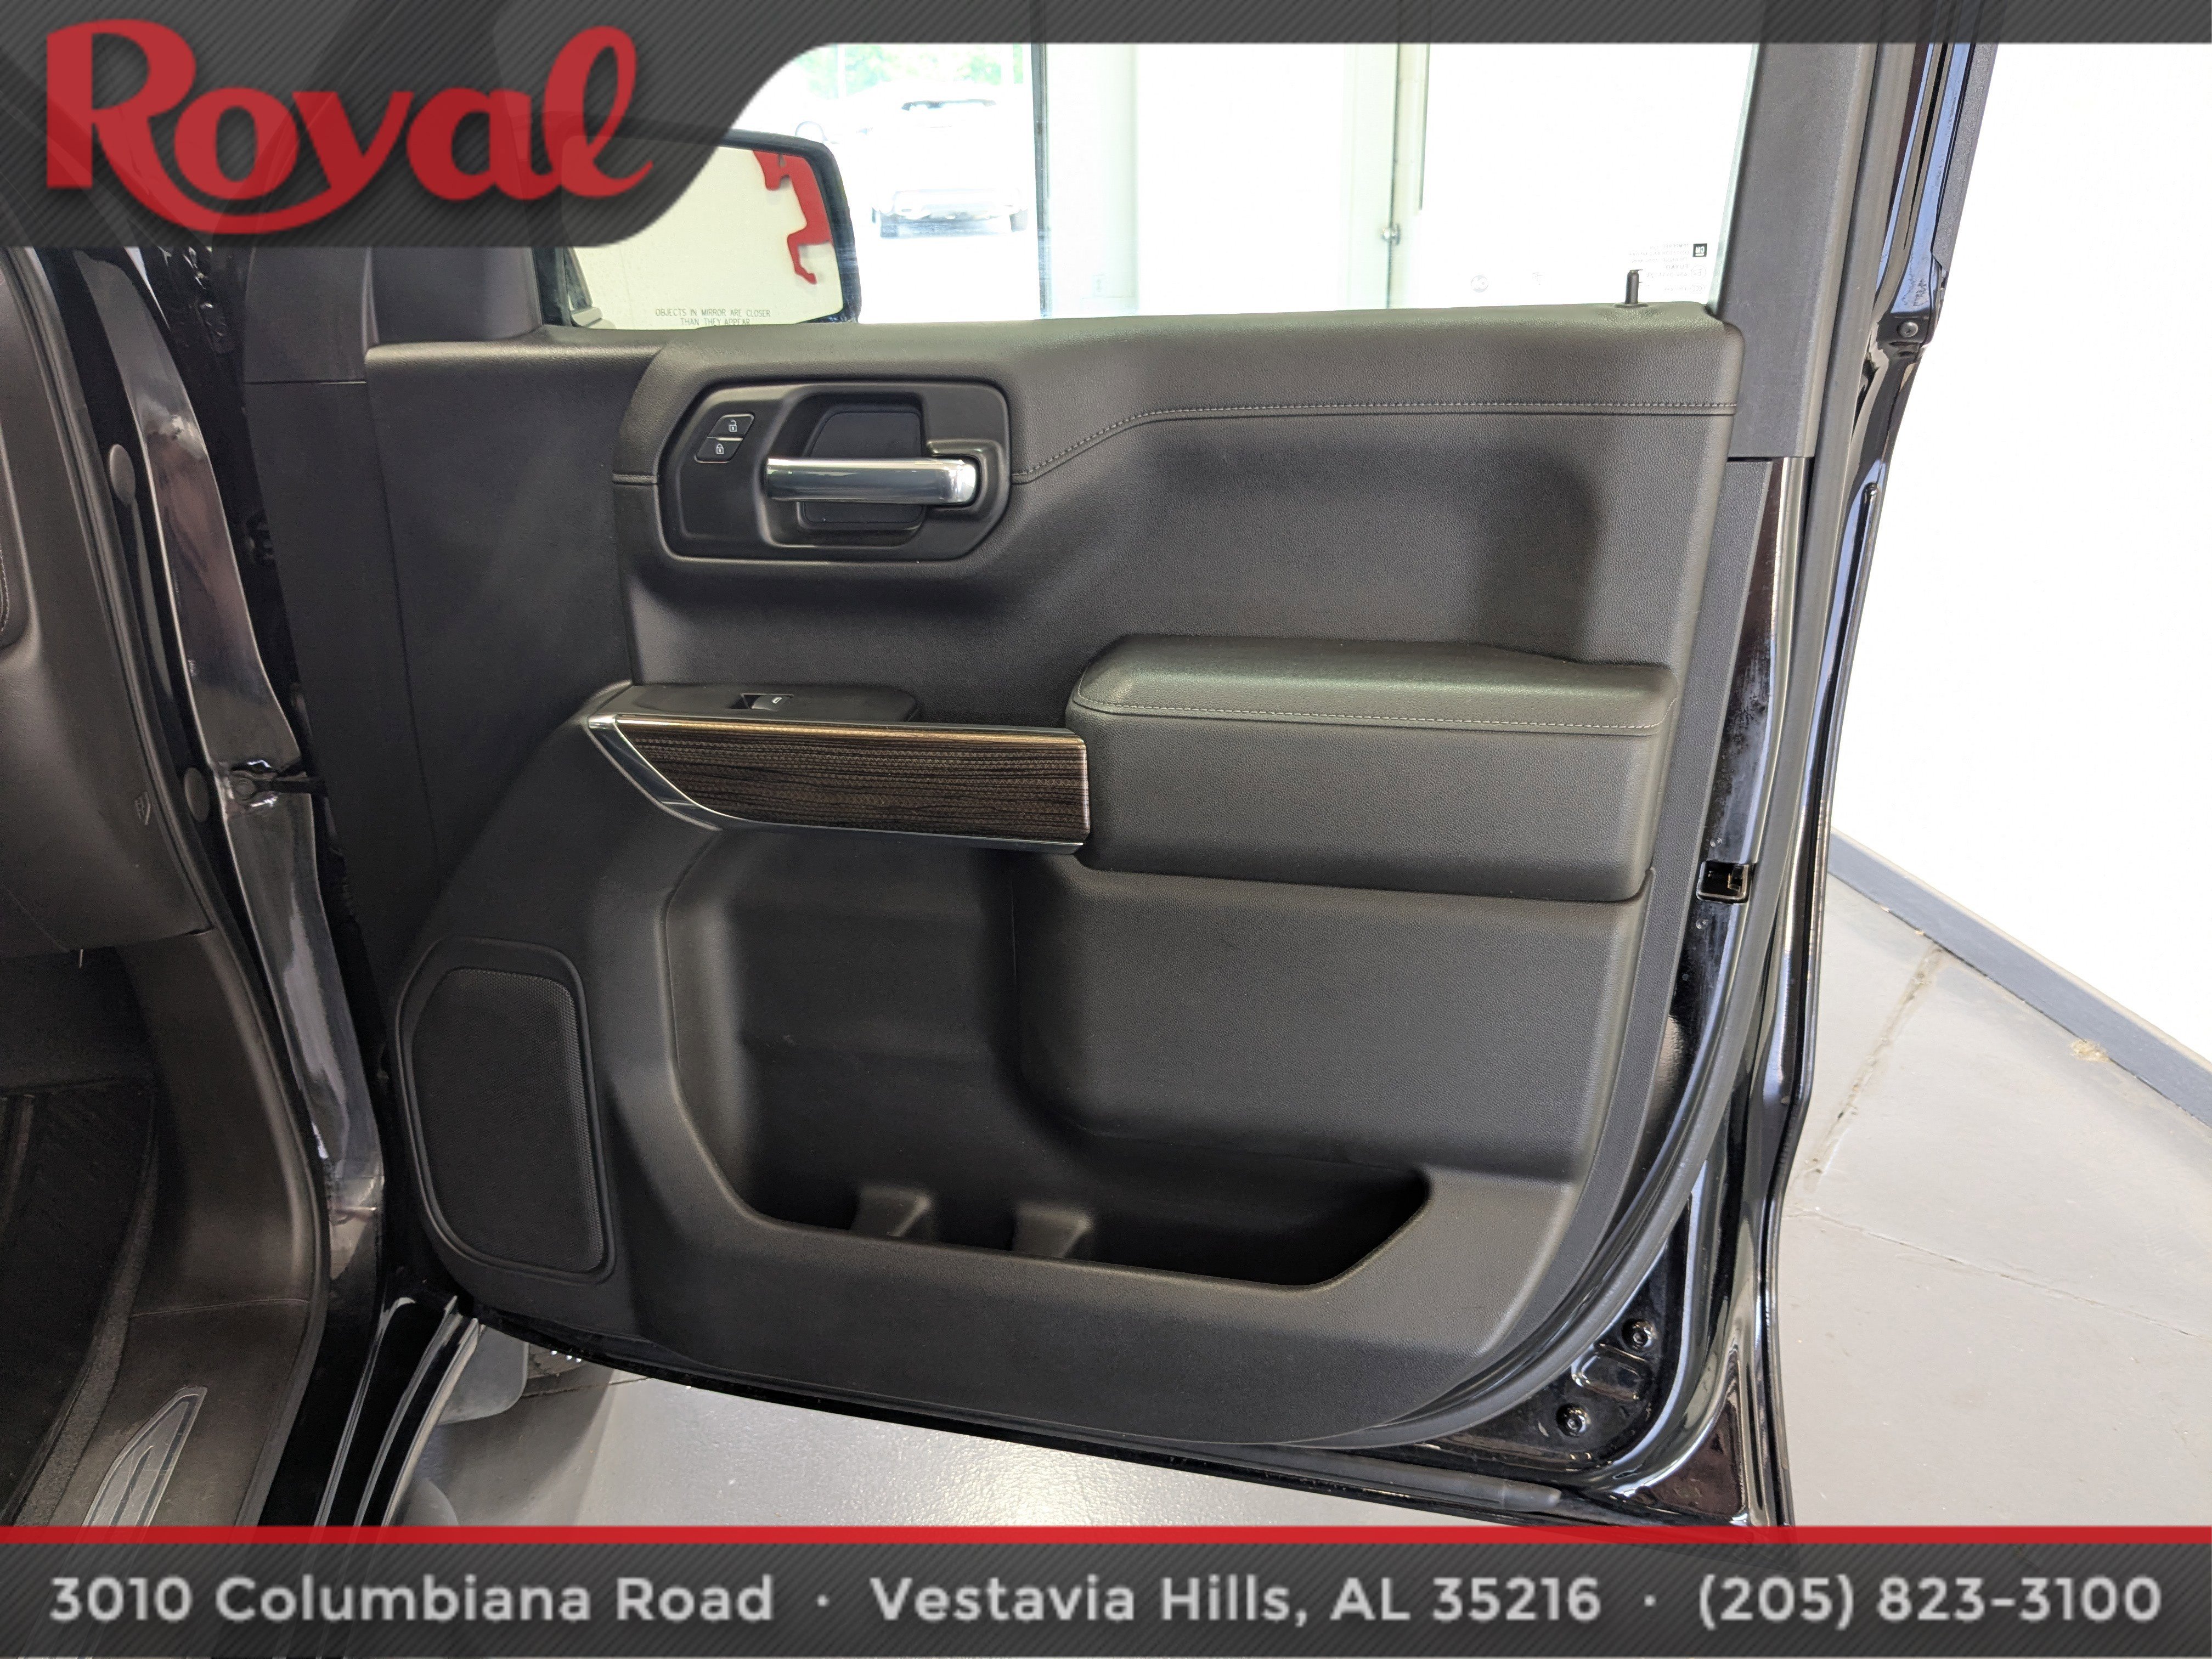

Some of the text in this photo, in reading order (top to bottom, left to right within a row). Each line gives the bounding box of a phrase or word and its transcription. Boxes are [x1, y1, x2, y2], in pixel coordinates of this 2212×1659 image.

[656, 308, 686, 317] OBJECTS
[701, 309, 727, 317] MIRROR
[746, 309, 771, 318] CLOSER
